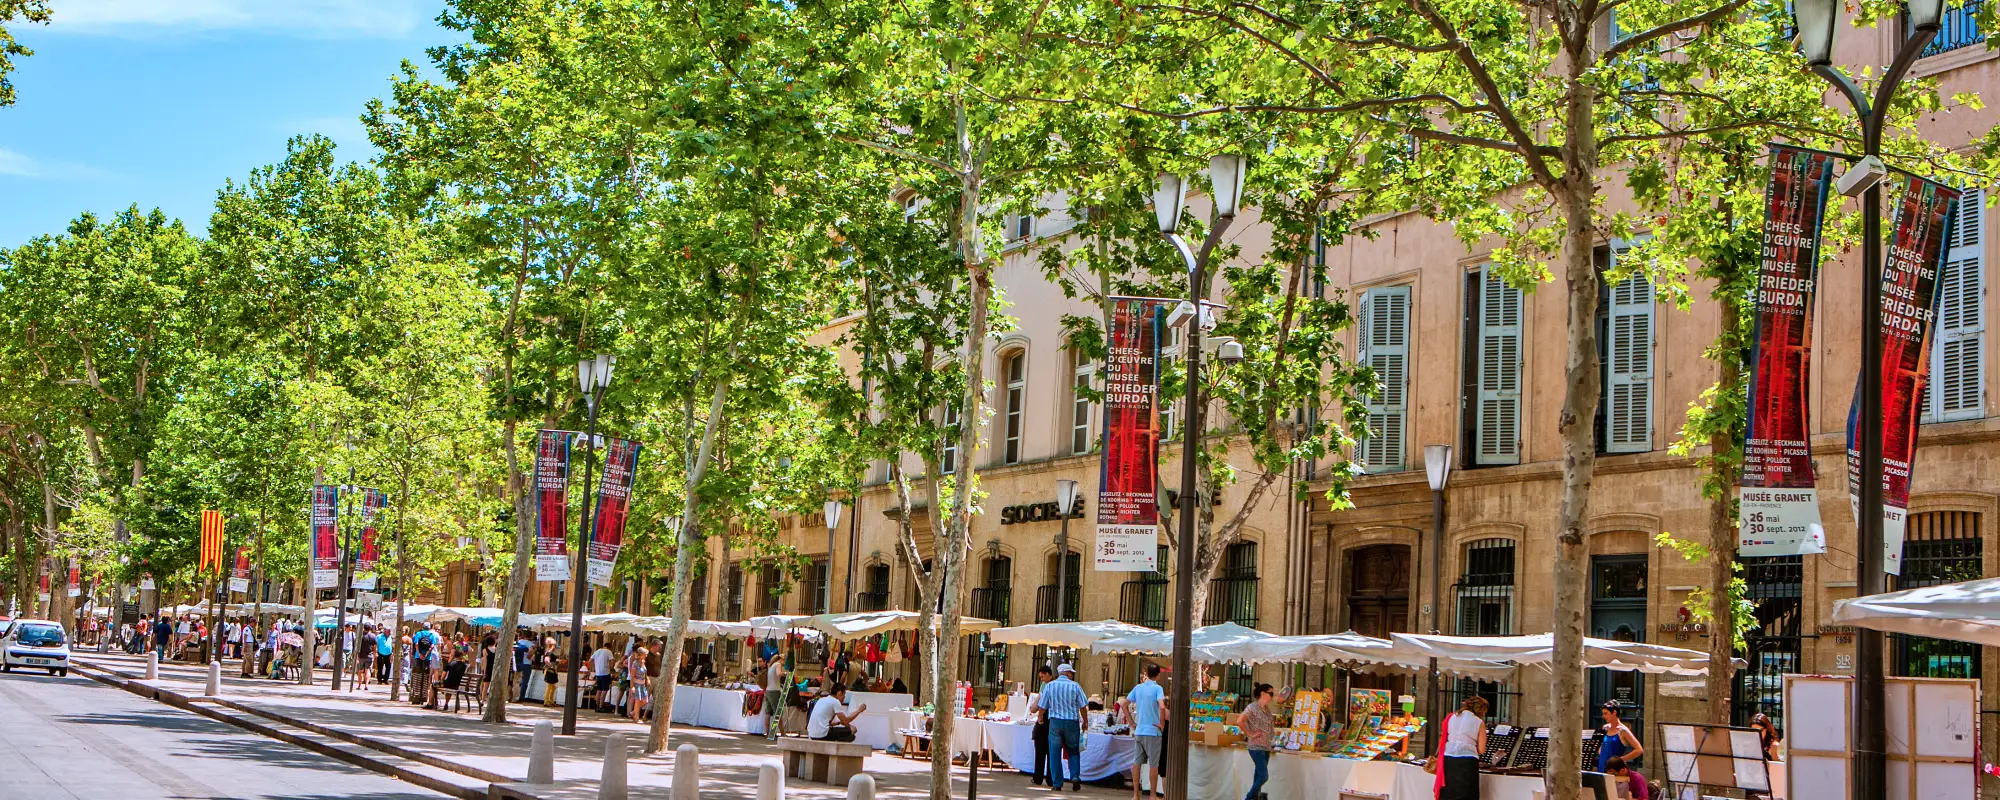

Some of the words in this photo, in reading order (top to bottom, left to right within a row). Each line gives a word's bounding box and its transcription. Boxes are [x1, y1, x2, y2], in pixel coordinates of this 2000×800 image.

[1772, 162, 1802, 171] GRANET
[1765, 220, 1803, 234] CHEFS-
[1764, 233, 1812, 249] D'ŒUVRE
[1763, 247, 1777, 257] DU
[1890, 244, 1924, 263] CHEFS-
[1762, 260, 1796, 273] MUSÉE
[1887, 257, 1934, 280] D'ŒUVRE
[1885, 269, 1899, 281] DU
[1760, 275, 1813, 292] FRIEDER
[1882, 281, 1915, 300] MUSÉE
[1759, 290, 1803, 306] BURDA
[1758, 305, 1803, 315] BADEN-BADEN
[1881, 312, 1921, 334] URDA
[1881, 327, 1920, 342] DEN-BADEN
[1108, 347, 1143, 355] CHEFS-
[1108, 356, 1152, 364] D'ŒUVRE
[1108, 364, 1120, 372] DU
[1107, 372, 1139, 381] MUSÉE
[1106, 383, 1157, 394] FRIEDER
[1106, 393, 1149, 403] BURDA
[1746, 438, 1769, 446] BASELITZ
[1767, 456, 1790, 464] POLLOCK
[1884, 466, 1908, 477] PICASSO
[600, 488, 626, 497] BURDA
[601, 483, 631, 492] FRIEDER
[1743, 492, 1771, 501] MUSÉE
[1774, 494, 1811, 502] GRANET
[1750, 512, 1763, 522] 26
[1750, 523, 1764, 534] 30
[1767, 525, 1786, 535] sept.
[1836, 654, 1851, 666] SLR
